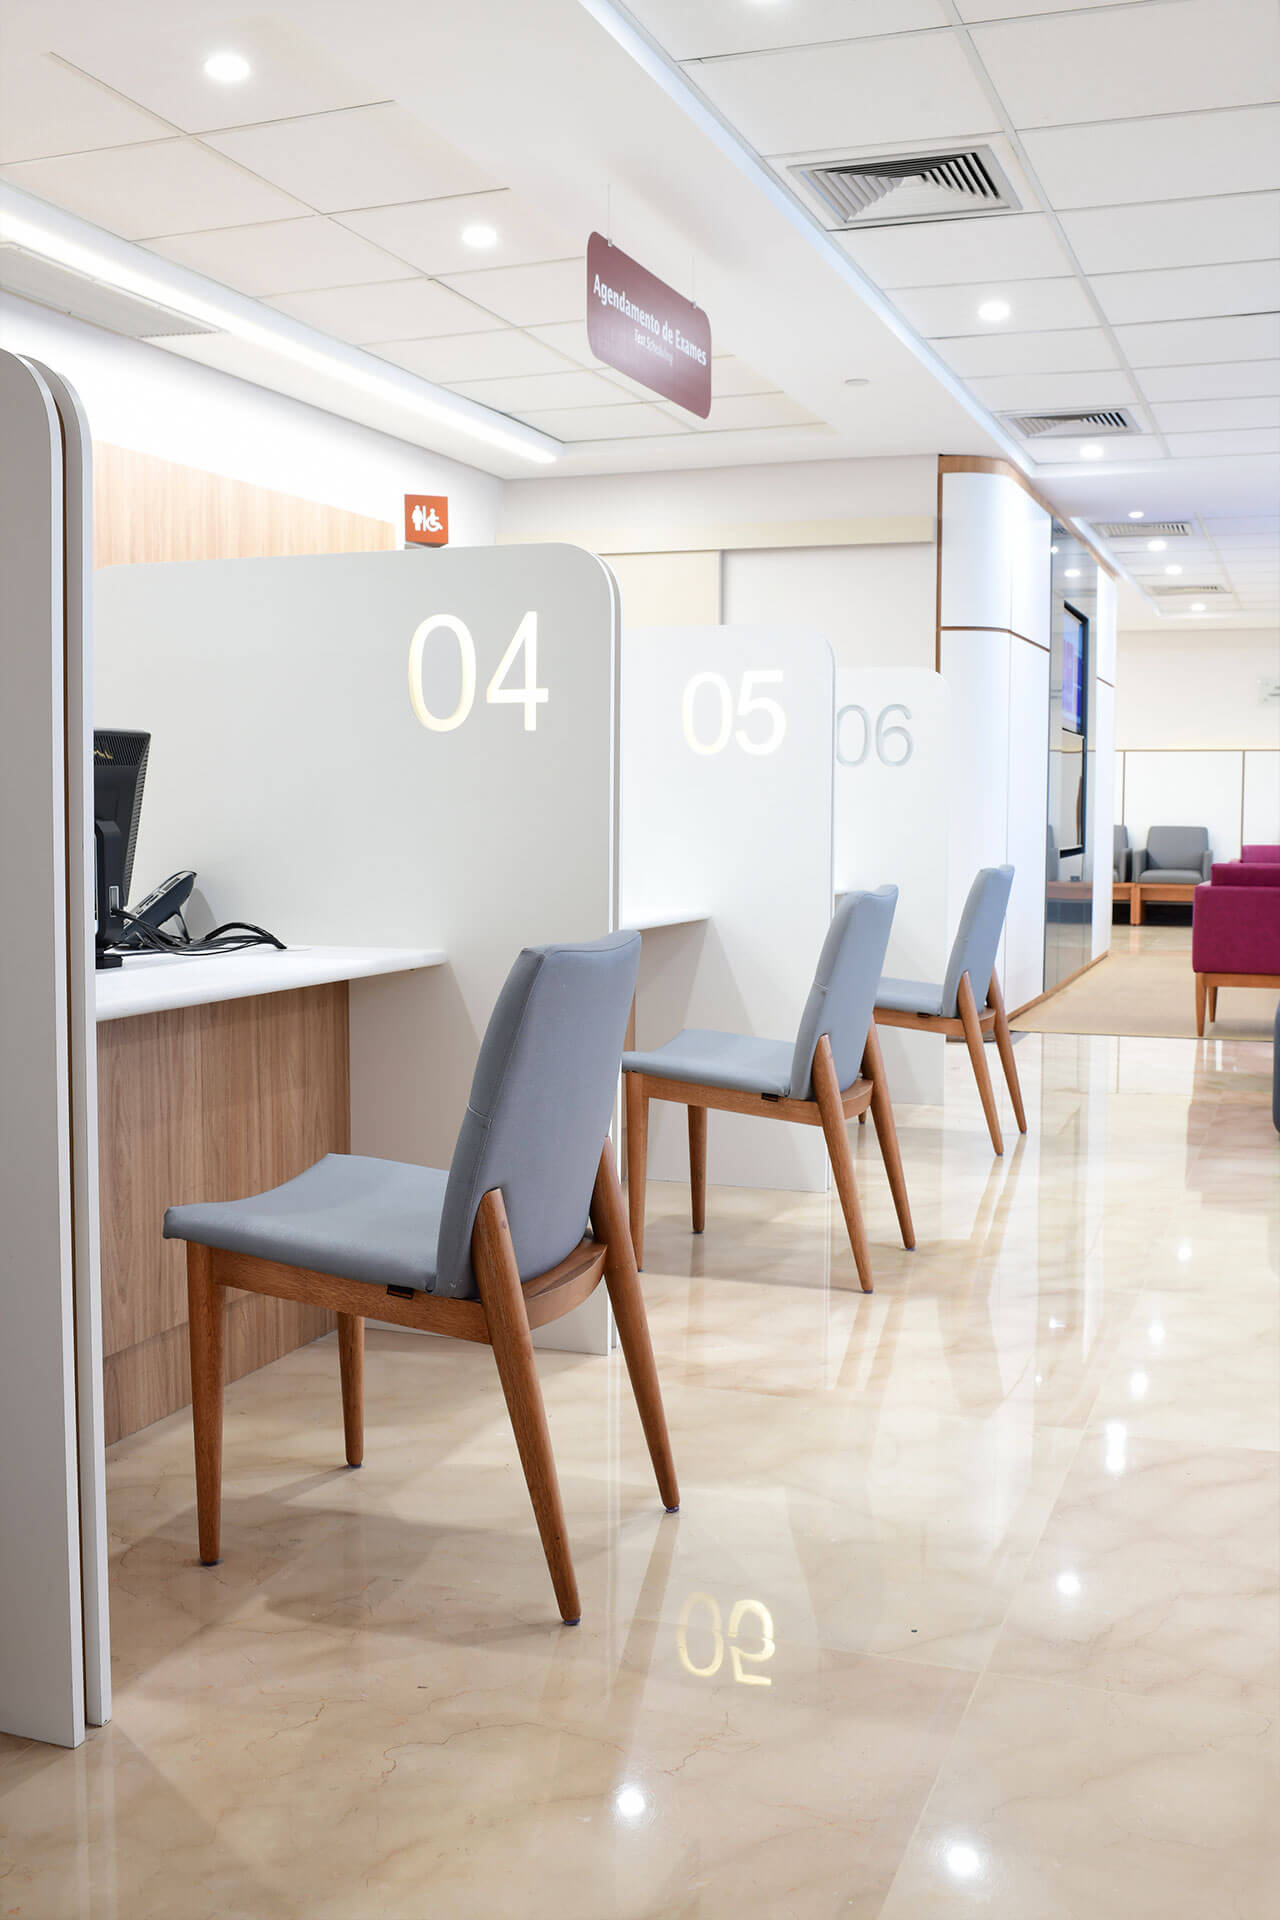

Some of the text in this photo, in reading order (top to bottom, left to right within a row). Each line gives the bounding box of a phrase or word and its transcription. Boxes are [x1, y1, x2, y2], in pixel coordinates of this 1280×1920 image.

[593, 274, 707, 367] Agendamento de Exames
[407, 610, 549, 733] 04
[682, 670, 787, 756] 05
[836, 703, 914, 768] 06
